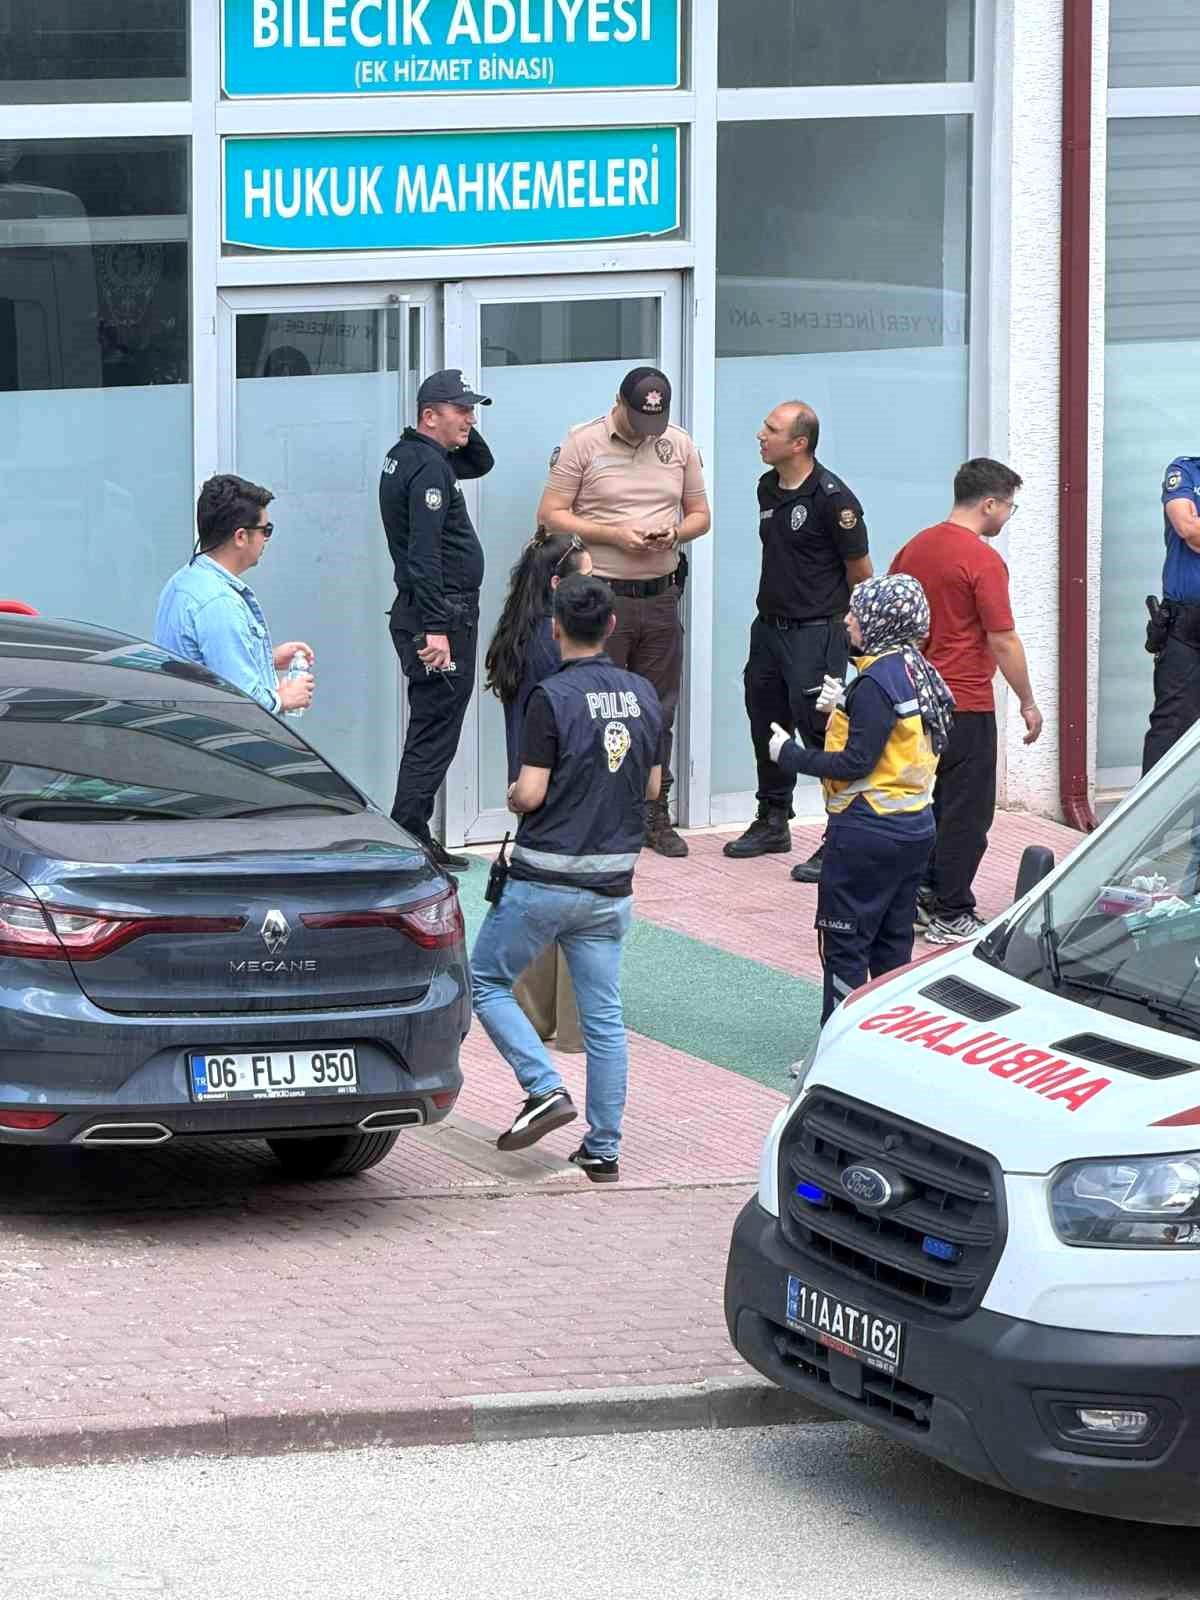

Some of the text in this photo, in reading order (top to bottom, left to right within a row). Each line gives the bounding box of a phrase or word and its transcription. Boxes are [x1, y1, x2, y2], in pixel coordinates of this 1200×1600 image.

[354, 53, 554, 88] (EK HİZMET BİNASI)
[243, 143, 660, 219] HUKUK MAHKEMELERİ
[228, 960, 318, 973] MEGANE
[195, 1077, 208, 1086] TR
[208, 1052, 354, 1088] 06 FLJ 950
[847, 1171, 876, 1198] Ford
